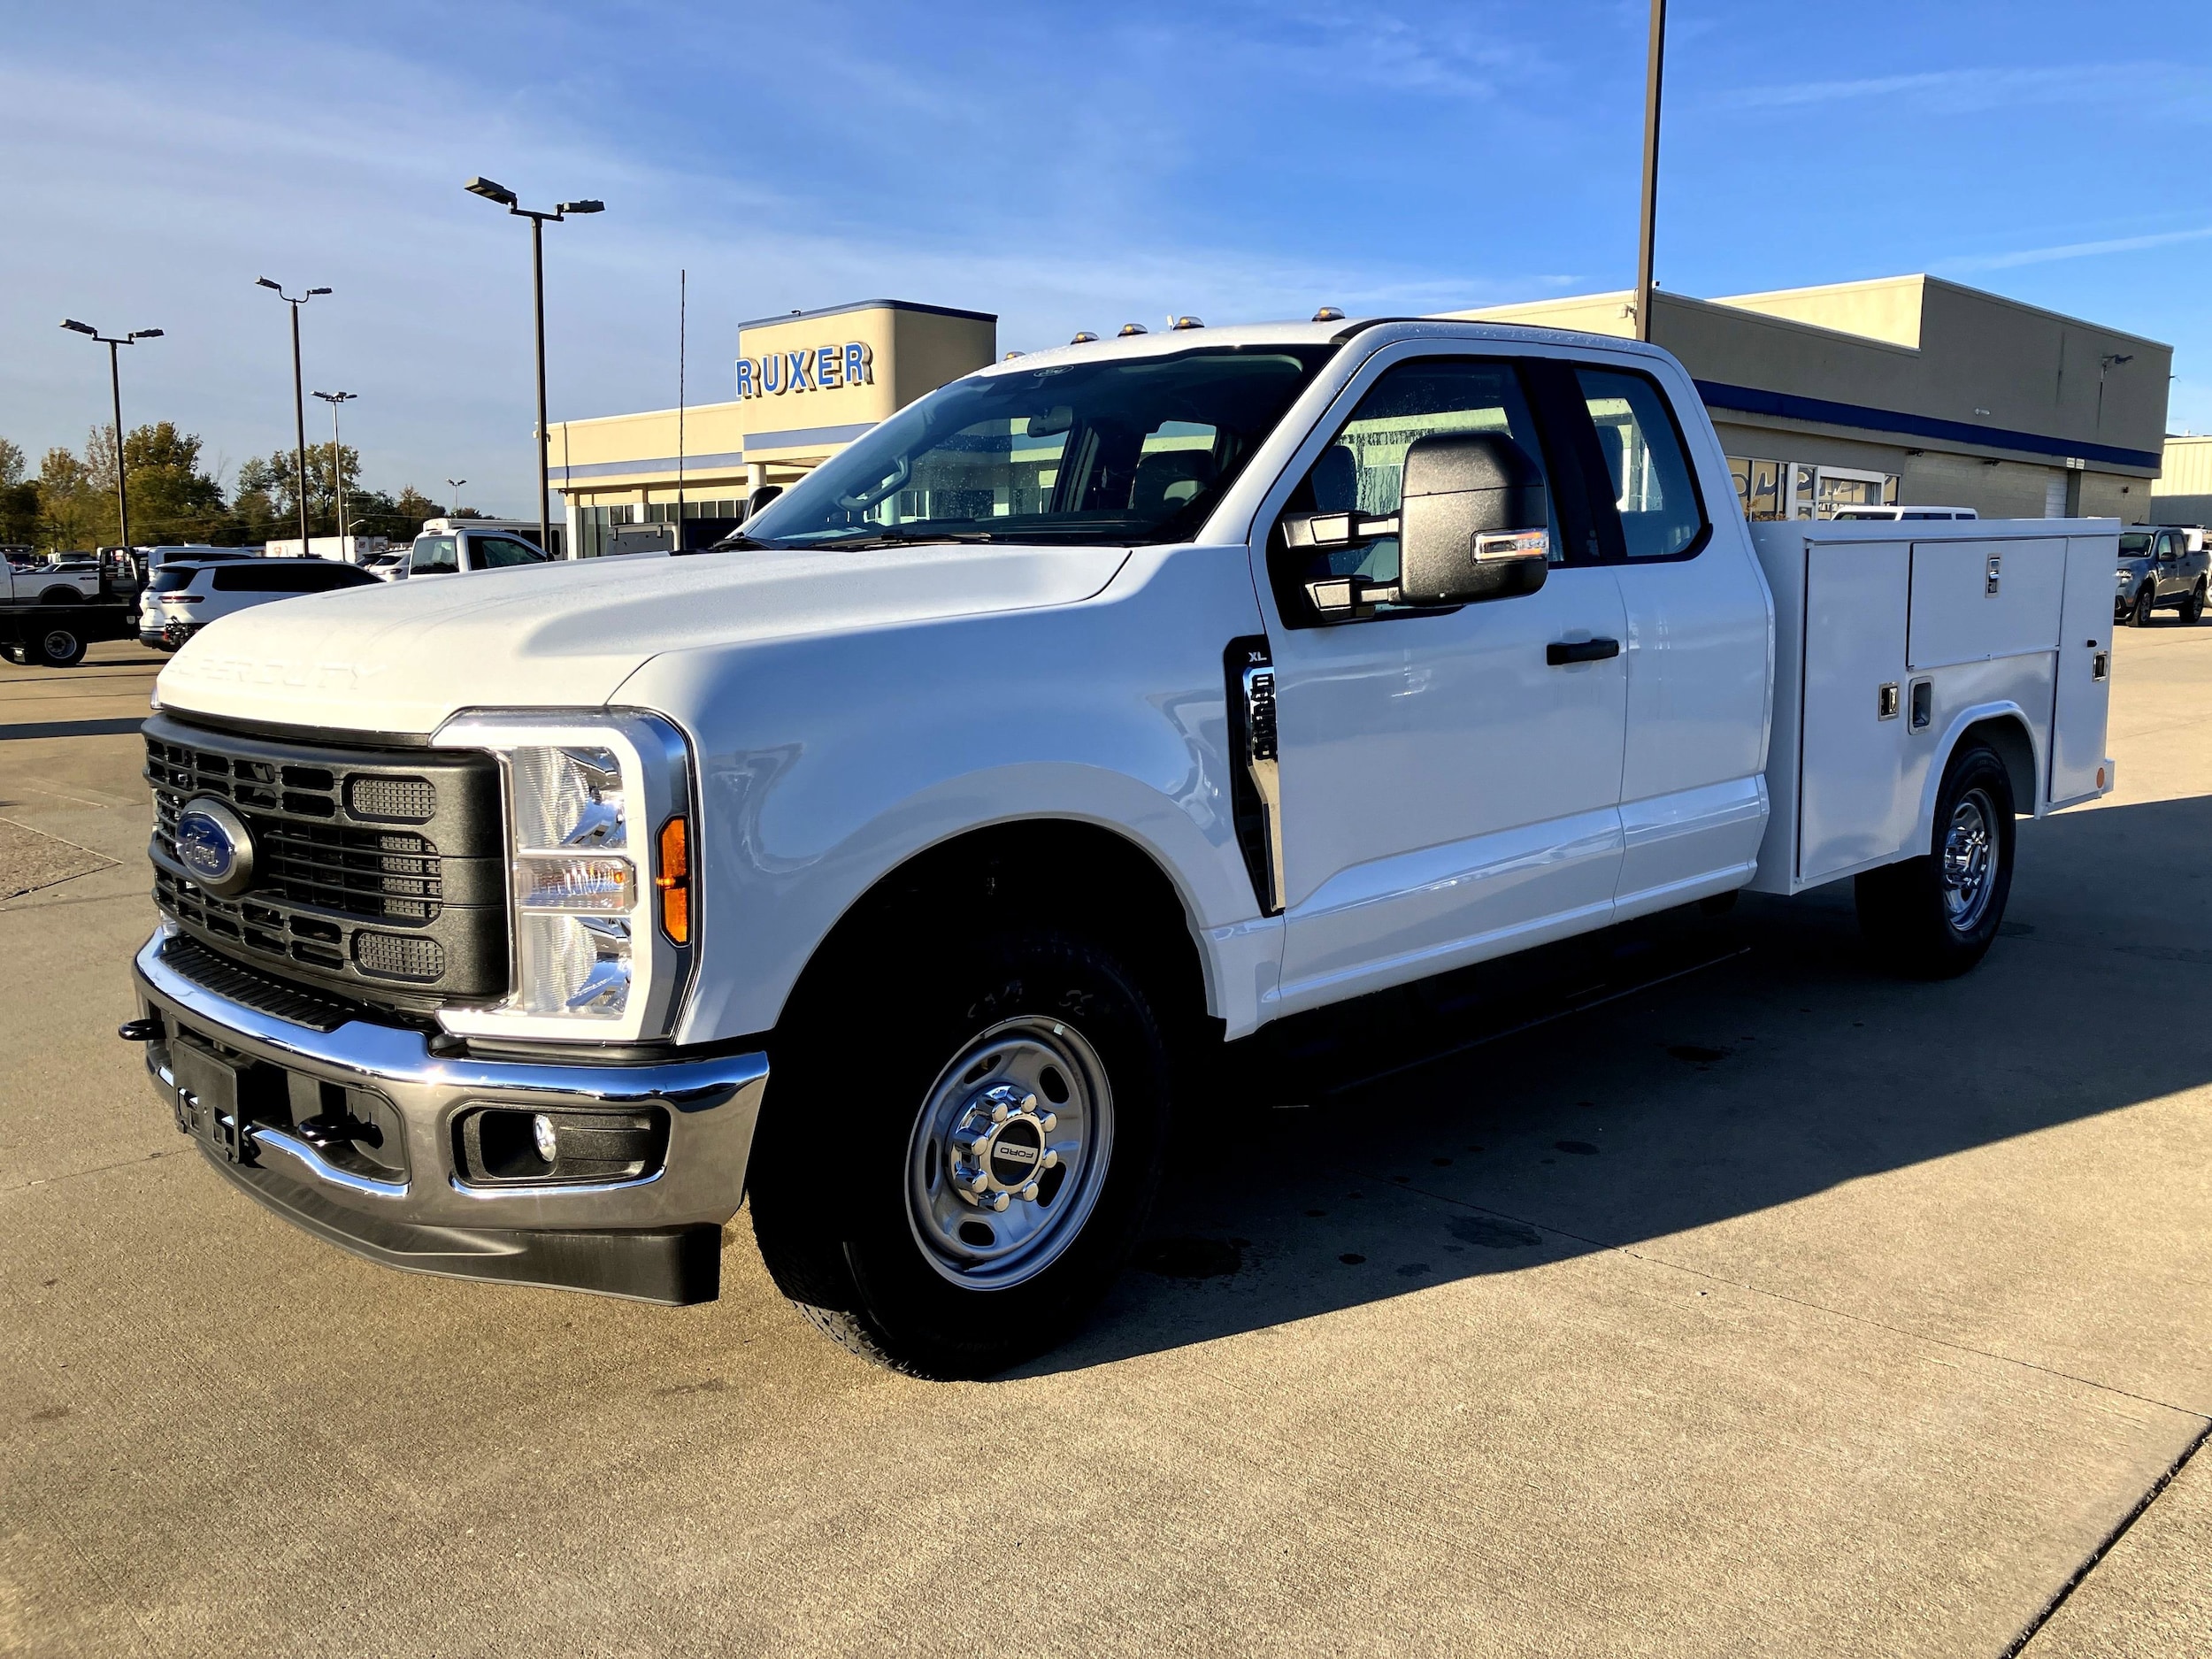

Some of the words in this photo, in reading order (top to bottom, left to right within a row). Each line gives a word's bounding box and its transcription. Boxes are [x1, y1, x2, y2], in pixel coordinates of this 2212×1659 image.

[735, 342, 873, 399] RUXER
[1248, 651, 1267, 662] XL
[1000, 1147, 1034, 1158] FORD
